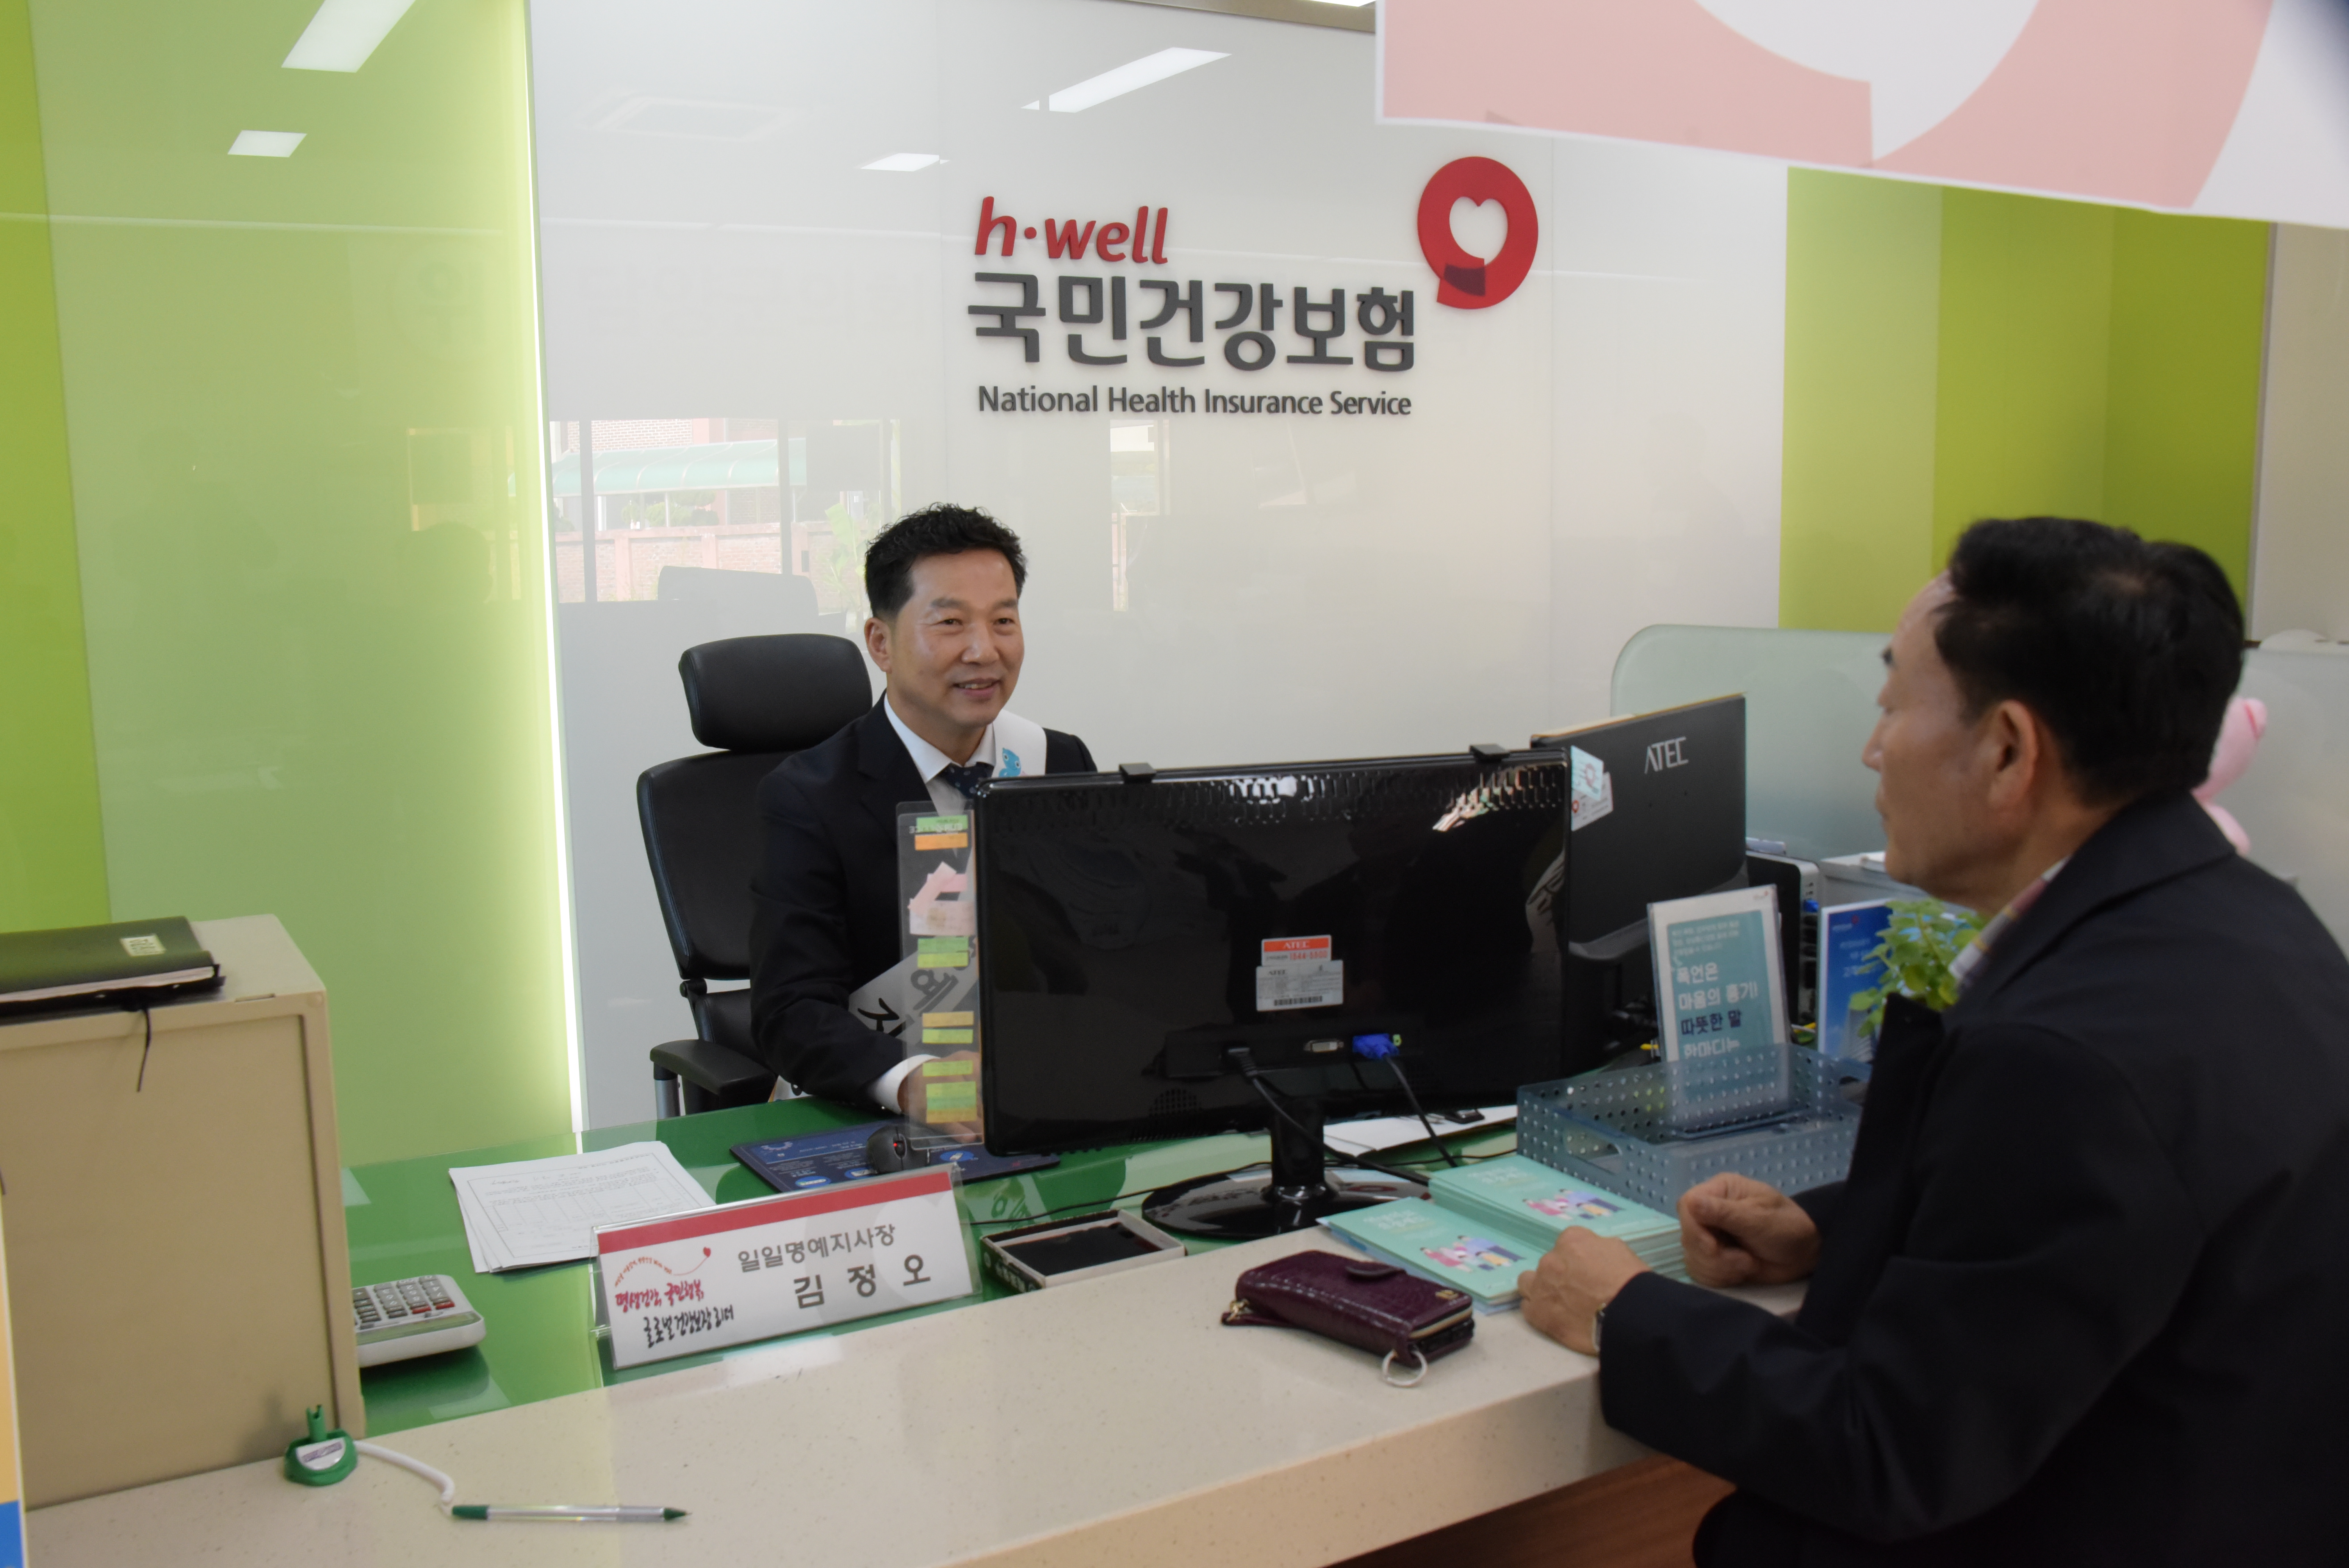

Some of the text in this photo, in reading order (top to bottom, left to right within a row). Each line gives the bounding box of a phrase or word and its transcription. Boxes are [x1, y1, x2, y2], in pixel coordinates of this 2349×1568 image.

[968, 272, 1414, 372] 국민건강보험
[978, 385, 1412, 415] National Health Insurance Service
[1644, 736, 1689, 774] ATEC
[738, 1224, 896, 1273] 일일명예지사장
[793, 1254, 932, 1309] 김 정 오
